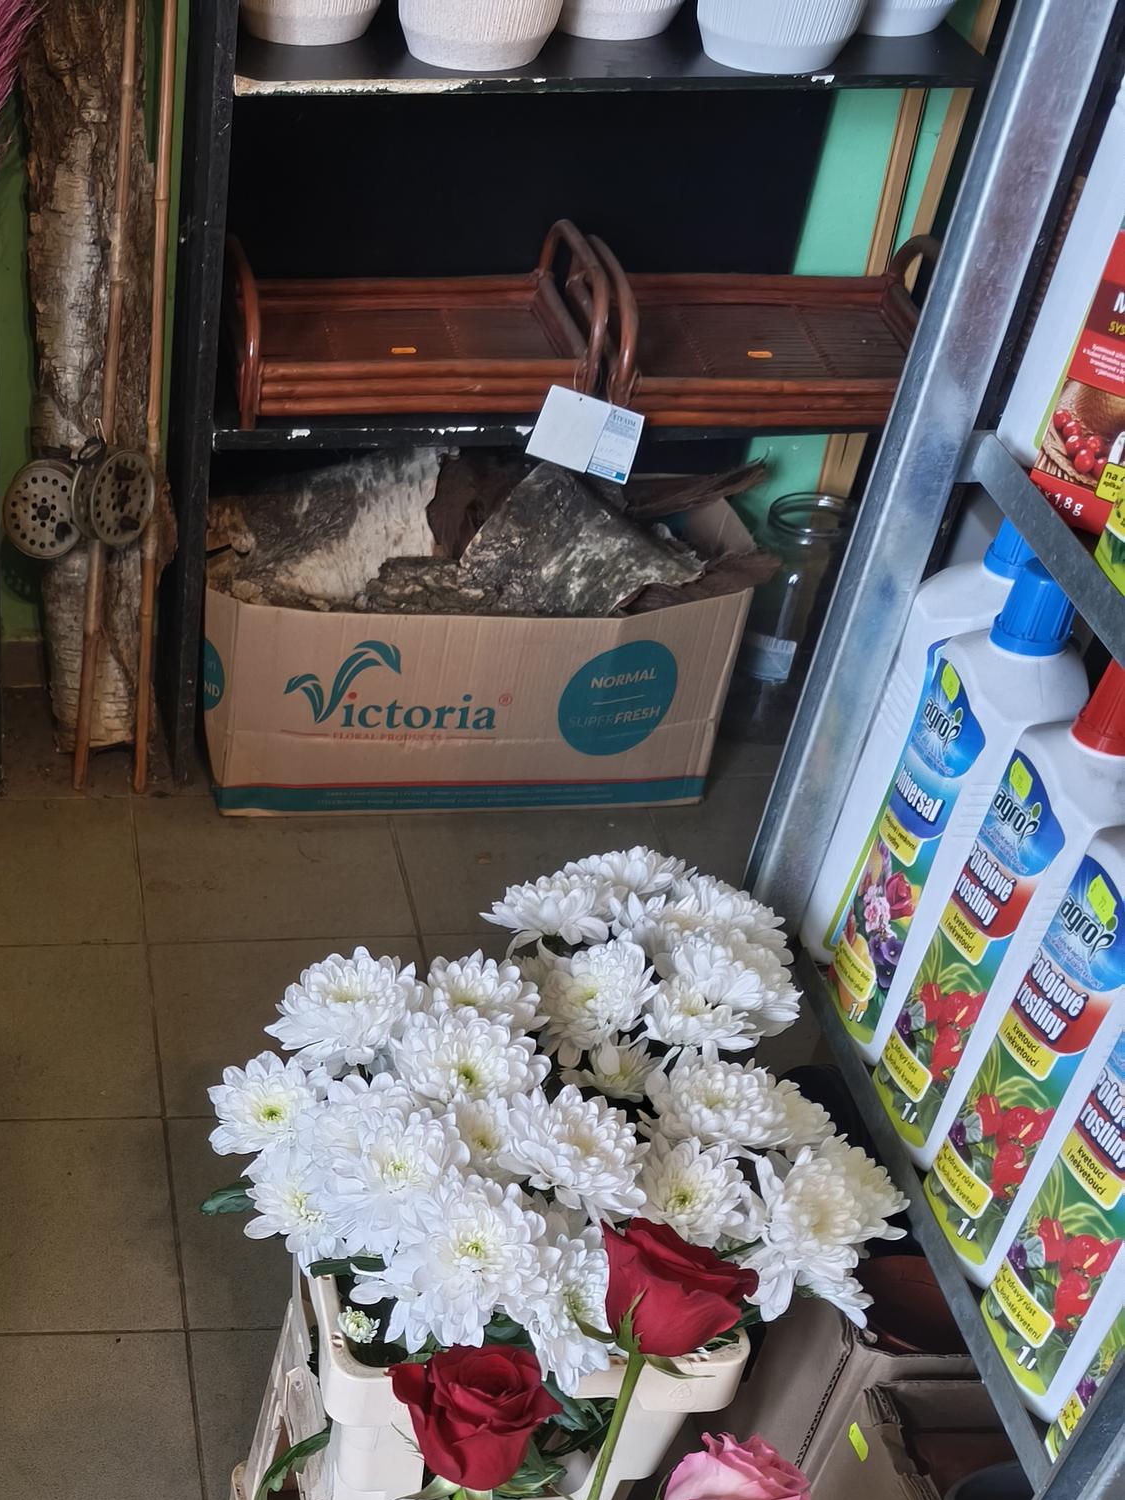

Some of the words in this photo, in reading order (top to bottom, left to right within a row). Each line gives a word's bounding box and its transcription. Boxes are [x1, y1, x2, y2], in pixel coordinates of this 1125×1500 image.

[591, 667, 657, 689] NORMAL
[332, 731, 376, 741] FLORAL
[380, 732, 443, 742] PRODUCTS
[923, 700, 952, 741] agro
[993, 789, 1026, 835] agro
[955, 873, 999, 927] rostliny
[947, 923, 976, 954] nekvetoucí
[953, 912, 977, 940] kvetoucí
[1059, 894, 1101, 947] agro
[1016, 981, 1068, 1042] rostliny
[1006, 1033, 1039, 1068] nekvetoucí
[1012, 1022, 1039, 1054] kvetoucí
[1069, 1154, 1108, 1196] nekvetoucí
[1076, 1144, 1108, 1181] kvetoucí
[1006, 1278, 1025, 1303] zdravý
[1023, 1301, 1038, 1317] růst
[1016, 1310, 1042, 1341] kvetení
